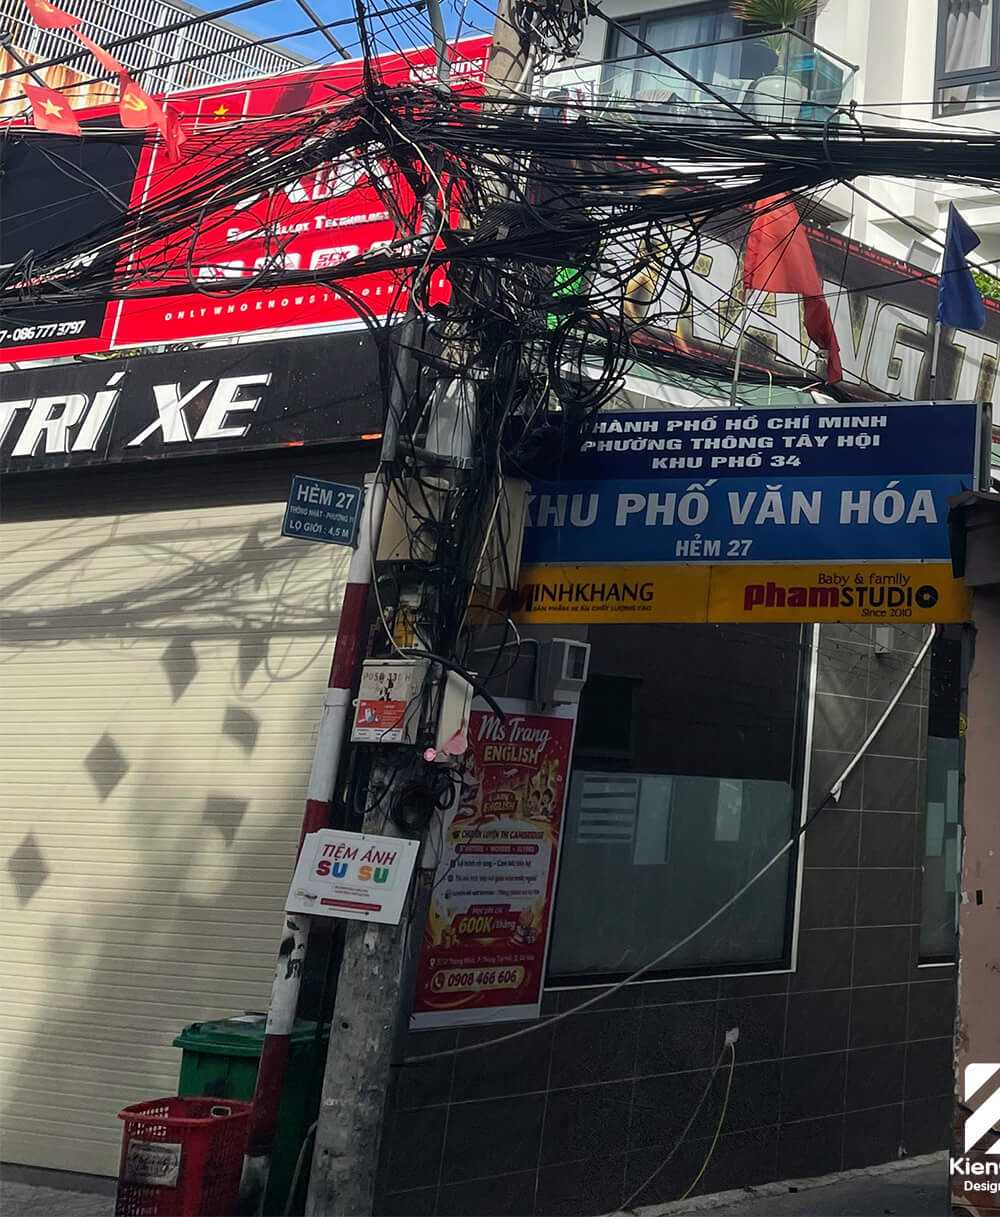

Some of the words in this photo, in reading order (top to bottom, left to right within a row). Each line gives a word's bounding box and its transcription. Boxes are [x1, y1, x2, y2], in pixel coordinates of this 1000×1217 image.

[122, 372, 273, 449] XE
[666, 415, 718, 432] PHỐ
[767, 414, 810, 430] CHÍ
[818, 415, 888, 429] MINH
[690, 435, 774, 450] THÔNG
[782, 433, 830, 448] TÂY
[837, 432, 881, 449] HỘI
[652, 456, 704, 469] KHU
[711, 451, 763, 468] PHỐ
[770, 455, 801, 468] 34
[336, 491, 355, 510] 27
[615, 478, 719, 527] PHỐ
[728, 484, 822, 526] VĂN
[839, 480, 938, 525] HÓA
[675, 533, 721, 557] HẺM
[727, 539, 753, 557] 27
[818, 572, 850, 587] Baby
[854, 573, 865, 585] &
[869, 572, 911, 587] family
[478, 714, 506, 742] Ms
[508, 717, 552, 753] Trang
[483, 744, 539, 764] ENGLISH
[322, 842, 359, 861] TIỆM
